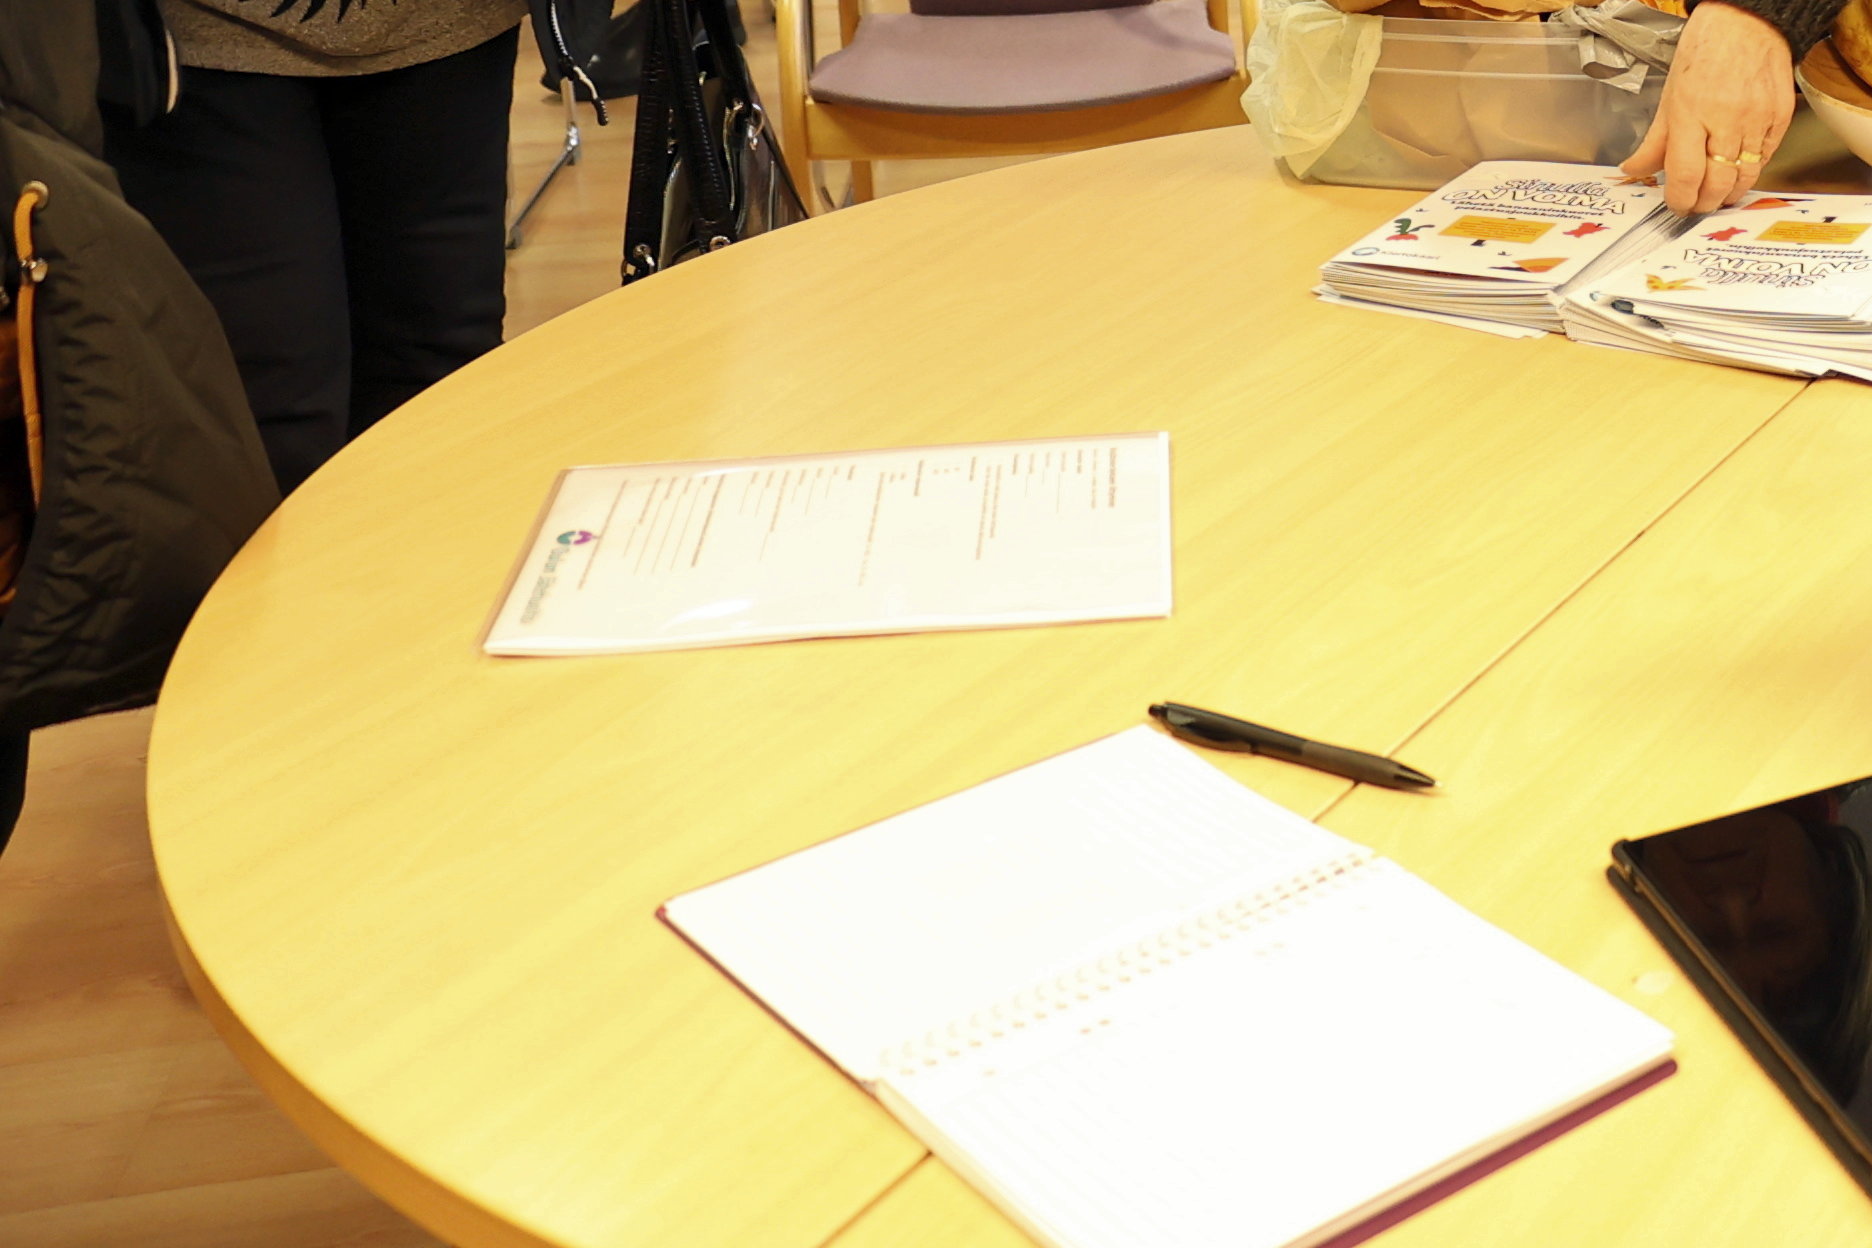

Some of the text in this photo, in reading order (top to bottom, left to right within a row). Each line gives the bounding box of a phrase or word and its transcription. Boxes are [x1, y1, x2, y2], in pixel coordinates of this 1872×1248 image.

[1442, 188, 1625, 214] ON VOIMA
[1684, 249, 1805, 275] VOIMA
